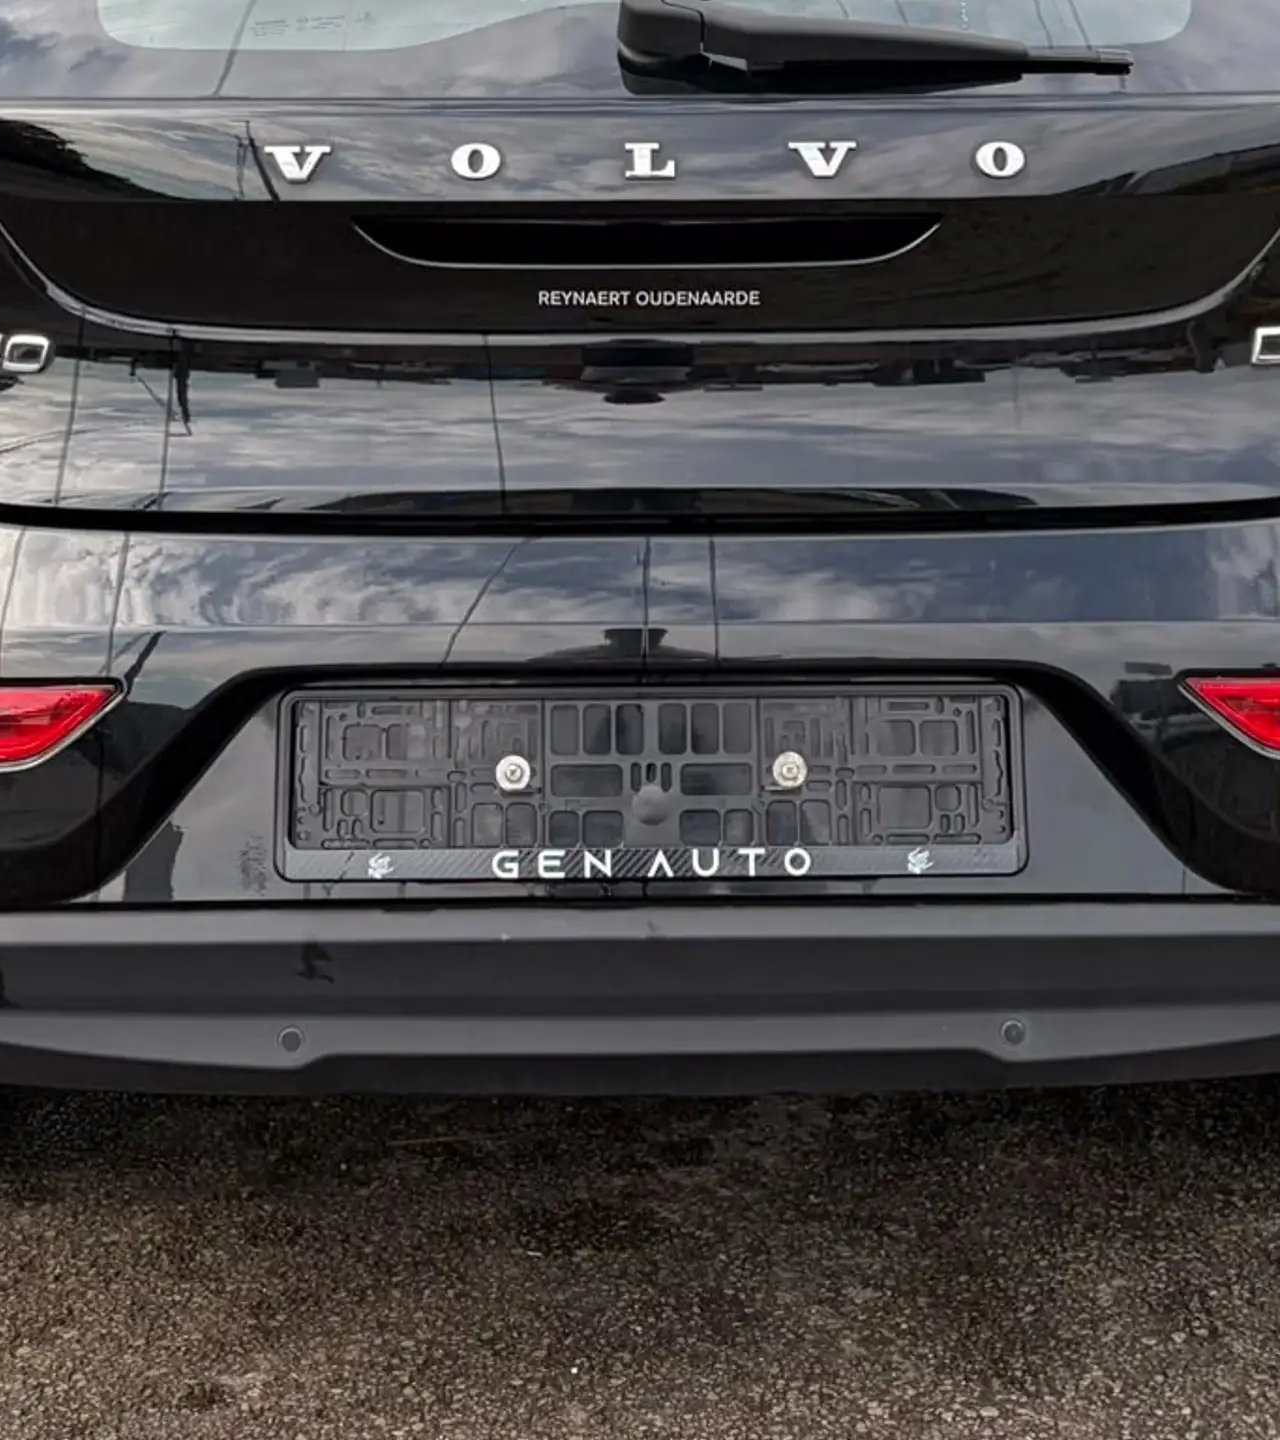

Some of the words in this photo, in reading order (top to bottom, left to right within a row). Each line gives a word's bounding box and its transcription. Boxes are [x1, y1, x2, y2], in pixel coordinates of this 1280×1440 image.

[264, 141, 1027, 180] VOLVO
[537, 290, 631, 306] REYNAERT
[635, 290, 761, 306] OUDENAARDE
[490, 849, 613, 879] GEN
[646, 847, 812, 878] AUTO
